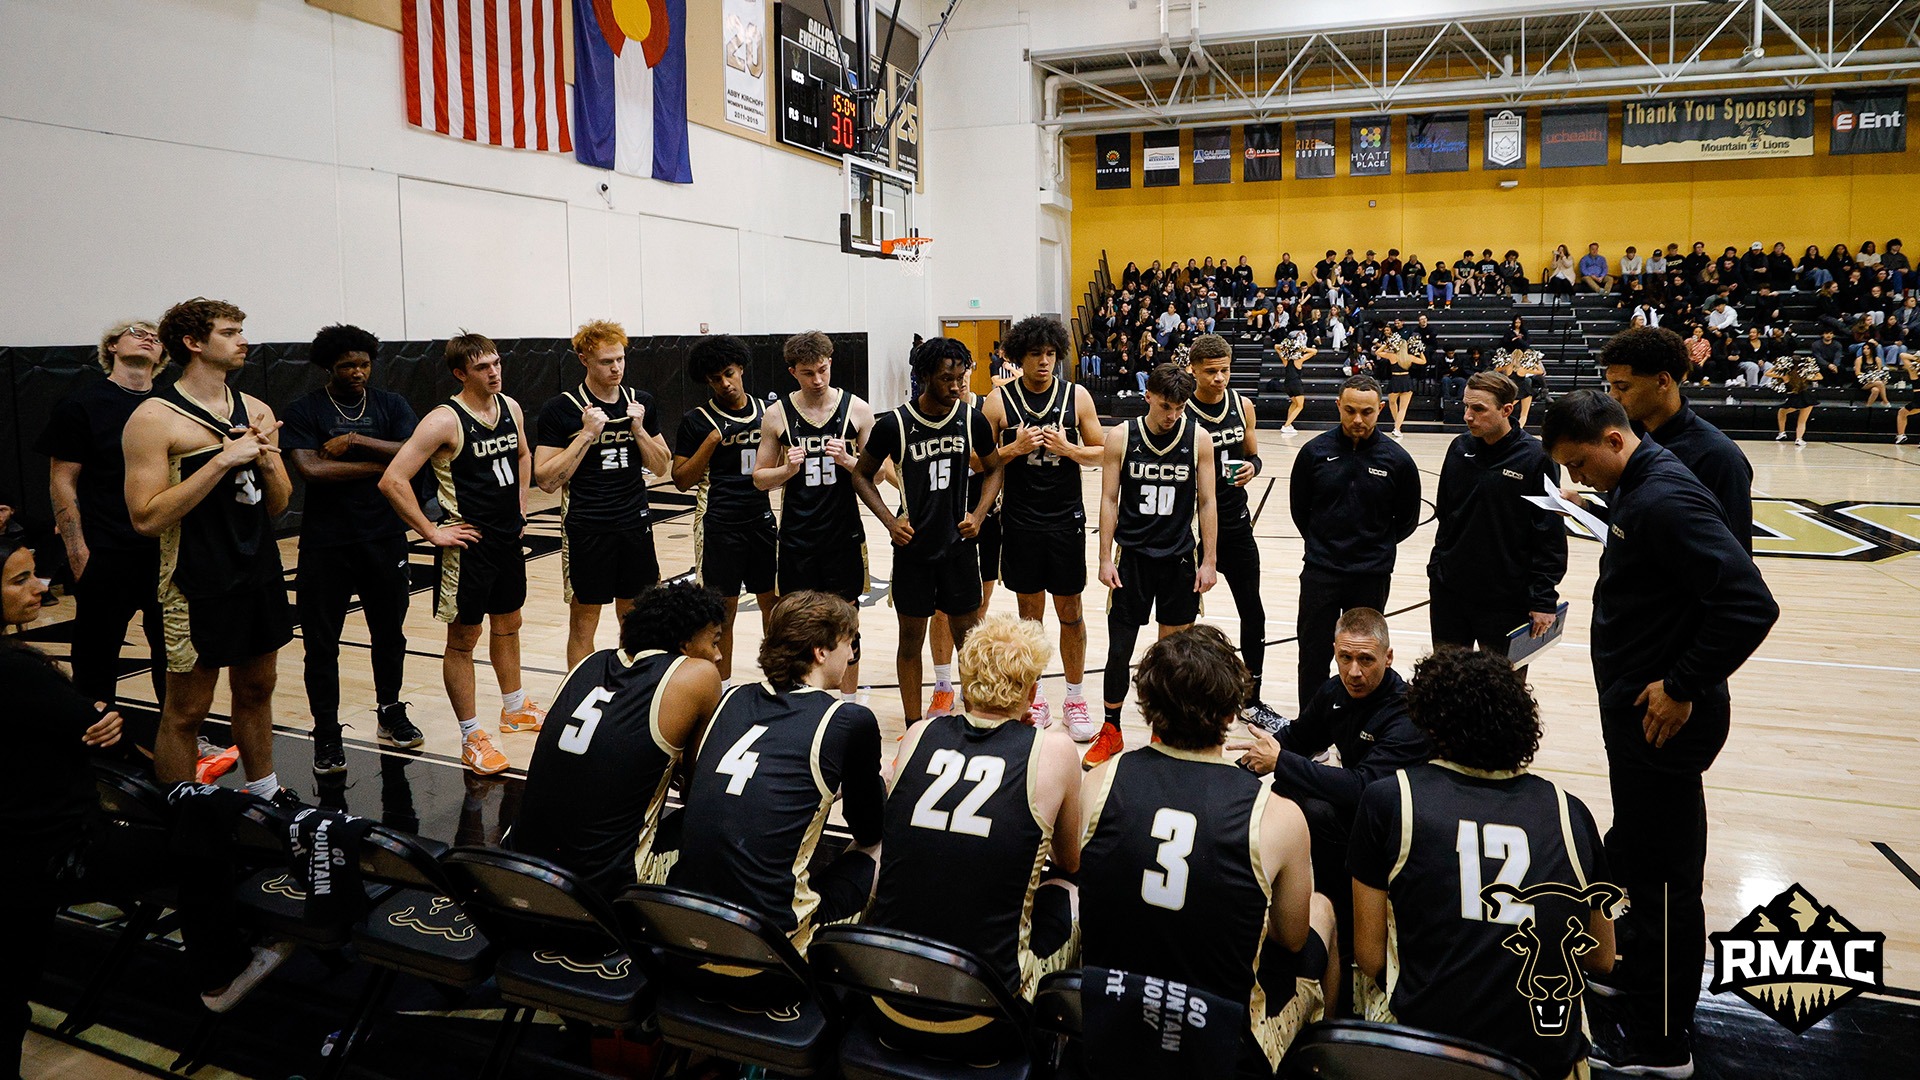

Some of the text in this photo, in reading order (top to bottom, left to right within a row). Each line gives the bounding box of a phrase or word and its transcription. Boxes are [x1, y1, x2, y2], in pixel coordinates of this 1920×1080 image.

[799, 28, 825, 55] EVENTS
[833, 94, 856, 117] 15:04
[1626, 98, 1806, 125] Thank You Sponsors
[831, 112, 853, 149] 30
[897, 98, 917, 145] 25
[1859, 110, 1901, 129] Ent
[1296, 139, 1315, 150] RIZE
[1545, 128, 1602, 145] uchealth
[1701, 140, 1790, 152] Mountain Lions
[1296, 149, 1335, 158] ROOFING
[1351, 151, 1390, 162] HYATT
[1356, 160, 1386, 168] PLACE
[473, 434, 518, 458] UCCS
[721, 428, 762, 447] UCC
[909, 436, 966, 462] UCCS
[600, 446, 629, 470] 21
[740, 448, 757, 476] 0
[1129, 461, 1190, 481] UCCS
[492, 457, 515, 487] 11
[805, 456, 838, 487] 55
[929, 459, 951, 491] 15
[1368, 467, 1388, 477] UCCS
[1502, 468, 1524, 480] UCCS
[1139, 484, 1176, 516] 30
[558, 686, 616, 755] 5
[715, 724, 769, 795] 4
[910, 748, 1006, 838] 22
[1141, 807, 1198, 911] 3
[1456, 819, 1536, 928] 12
[1187, 997, 1208, 1029] GO
